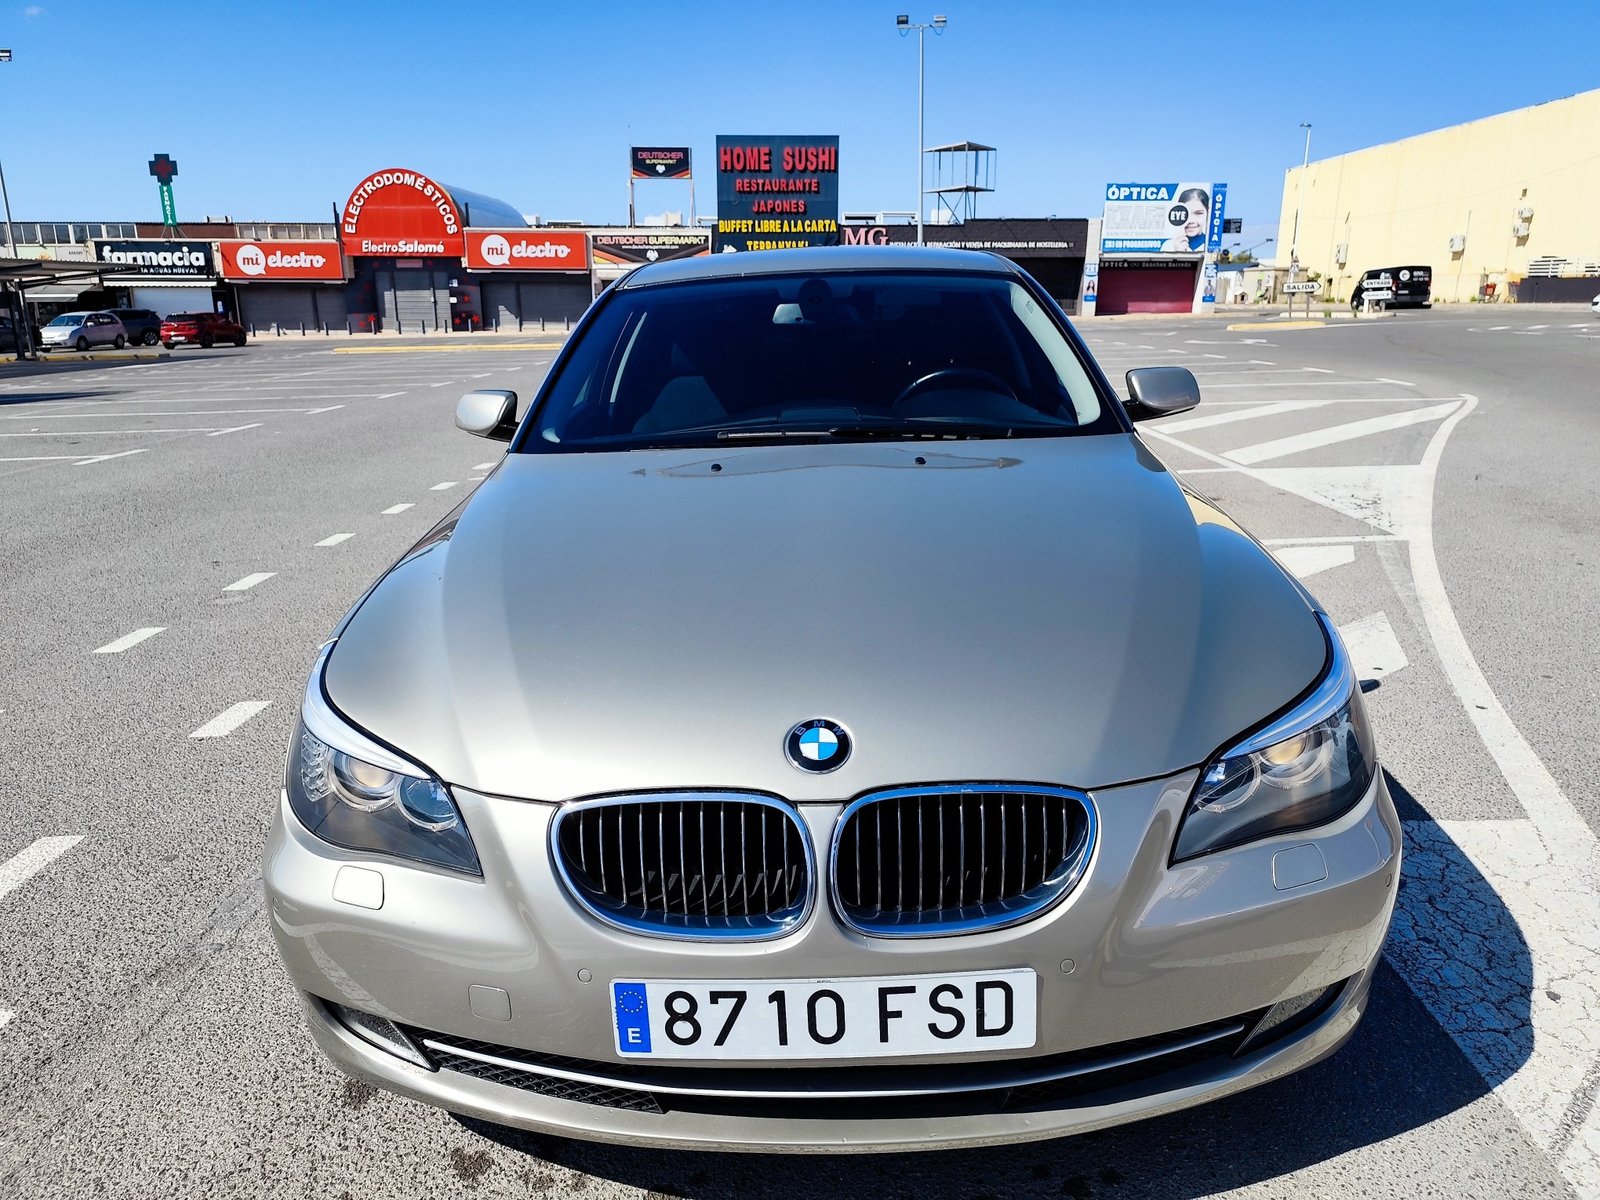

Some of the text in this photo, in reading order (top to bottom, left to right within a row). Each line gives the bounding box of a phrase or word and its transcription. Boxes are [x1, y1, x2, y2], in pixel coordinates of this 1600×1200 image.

[638, 151, 684, 159] DEUTSCHER
[720, 147, 836, 170] HOME SUSHI
[736, 179, 819, 191] RESTAURANTE
[1107, 184, 1168, 200] ÓPTICA
[163, 186, 173, 224] FARMACIA
[344, 172, 458, 235] ELECTRODOMÉSTICOS
[752, 200, 806, 212] JAPONES
[1170, 211, 1187, 221] EYE
[719, 220, 837, 232] BUFFET LIBRE A LA CARTA
[597, 236, 706, 245] DEUTSCHER SUPERMARKT
[843, 227, 889, 246] MG
[102, 246, 205, 267] farmacia
[487, 240, 571, 258] mi electro
[242, 250, 327, 268] mi electro
[795, 720, 845, 737] BMW
[664, 980, 1014, 1046] 8710 FSD
[627, 1028, 642, 1043] E
